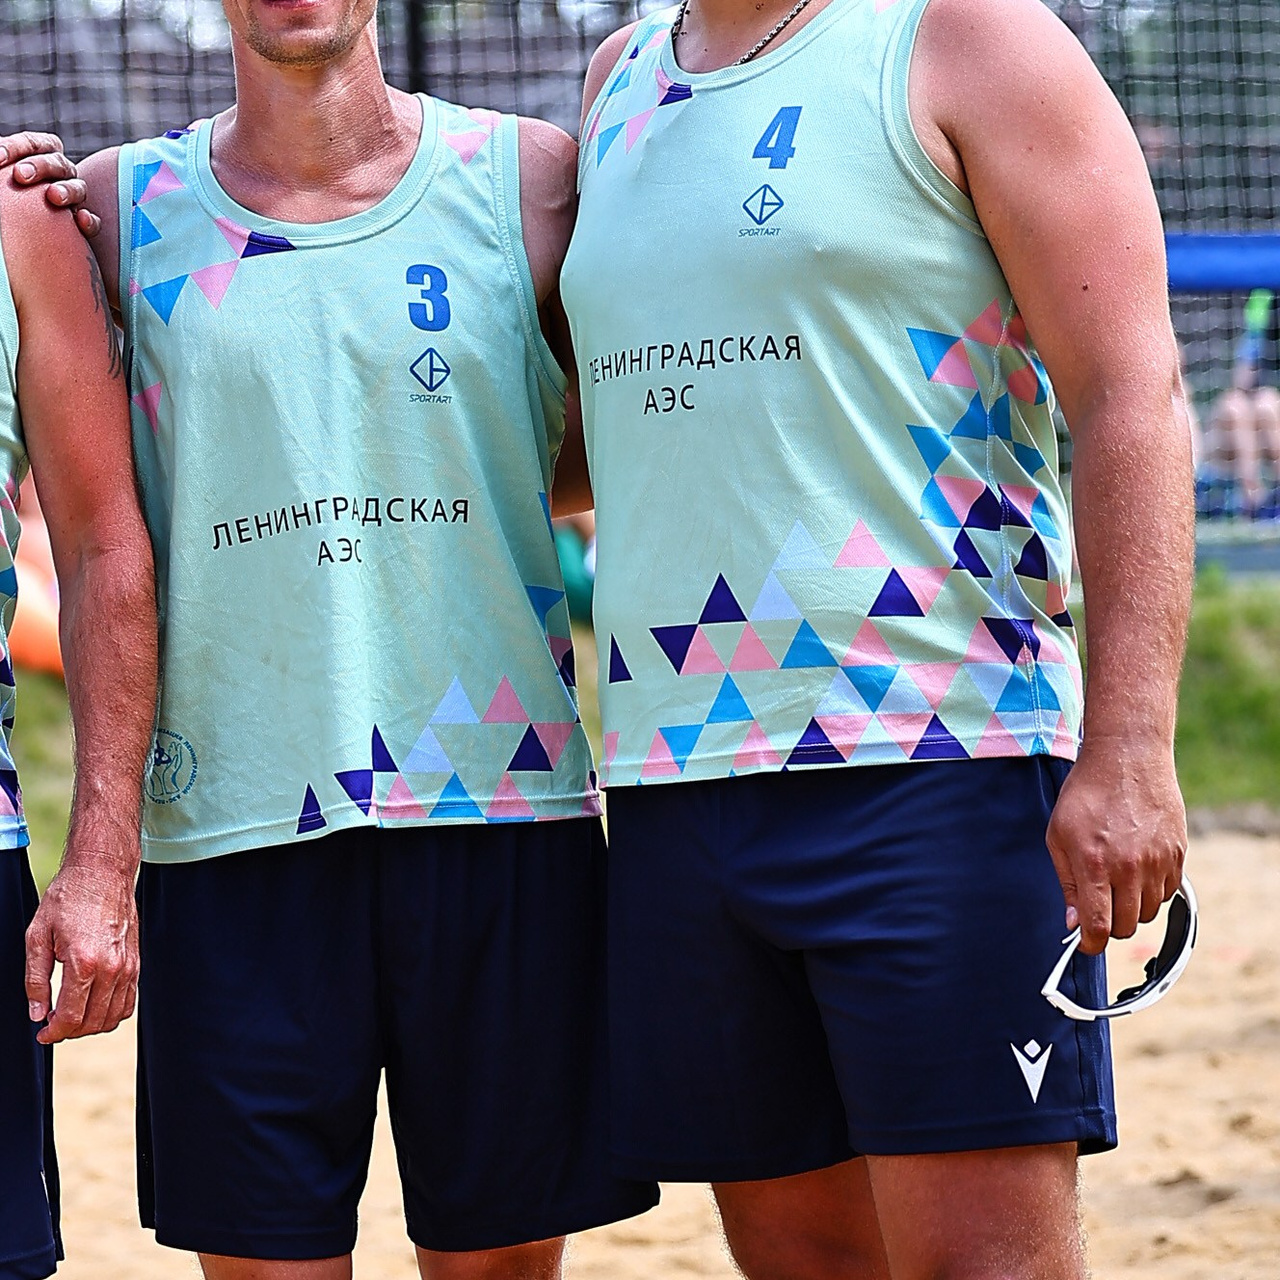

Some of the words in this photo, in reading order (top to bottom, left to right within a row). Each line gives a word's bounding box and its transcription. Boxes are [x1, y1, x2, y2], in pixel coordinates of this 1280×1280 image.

[752, 105, 803, 170] 4
[737, 227, 782, 238] SPORTART
[406, 264, 452, 332] 3
[408, 393, 453, 405] SPORTART
[643, 384, 695, 415] АЭС
[212, 496, 469, 550] ЛЕНИНГРАДСКАЯ
[317, 538, 363, 568] АЭС
